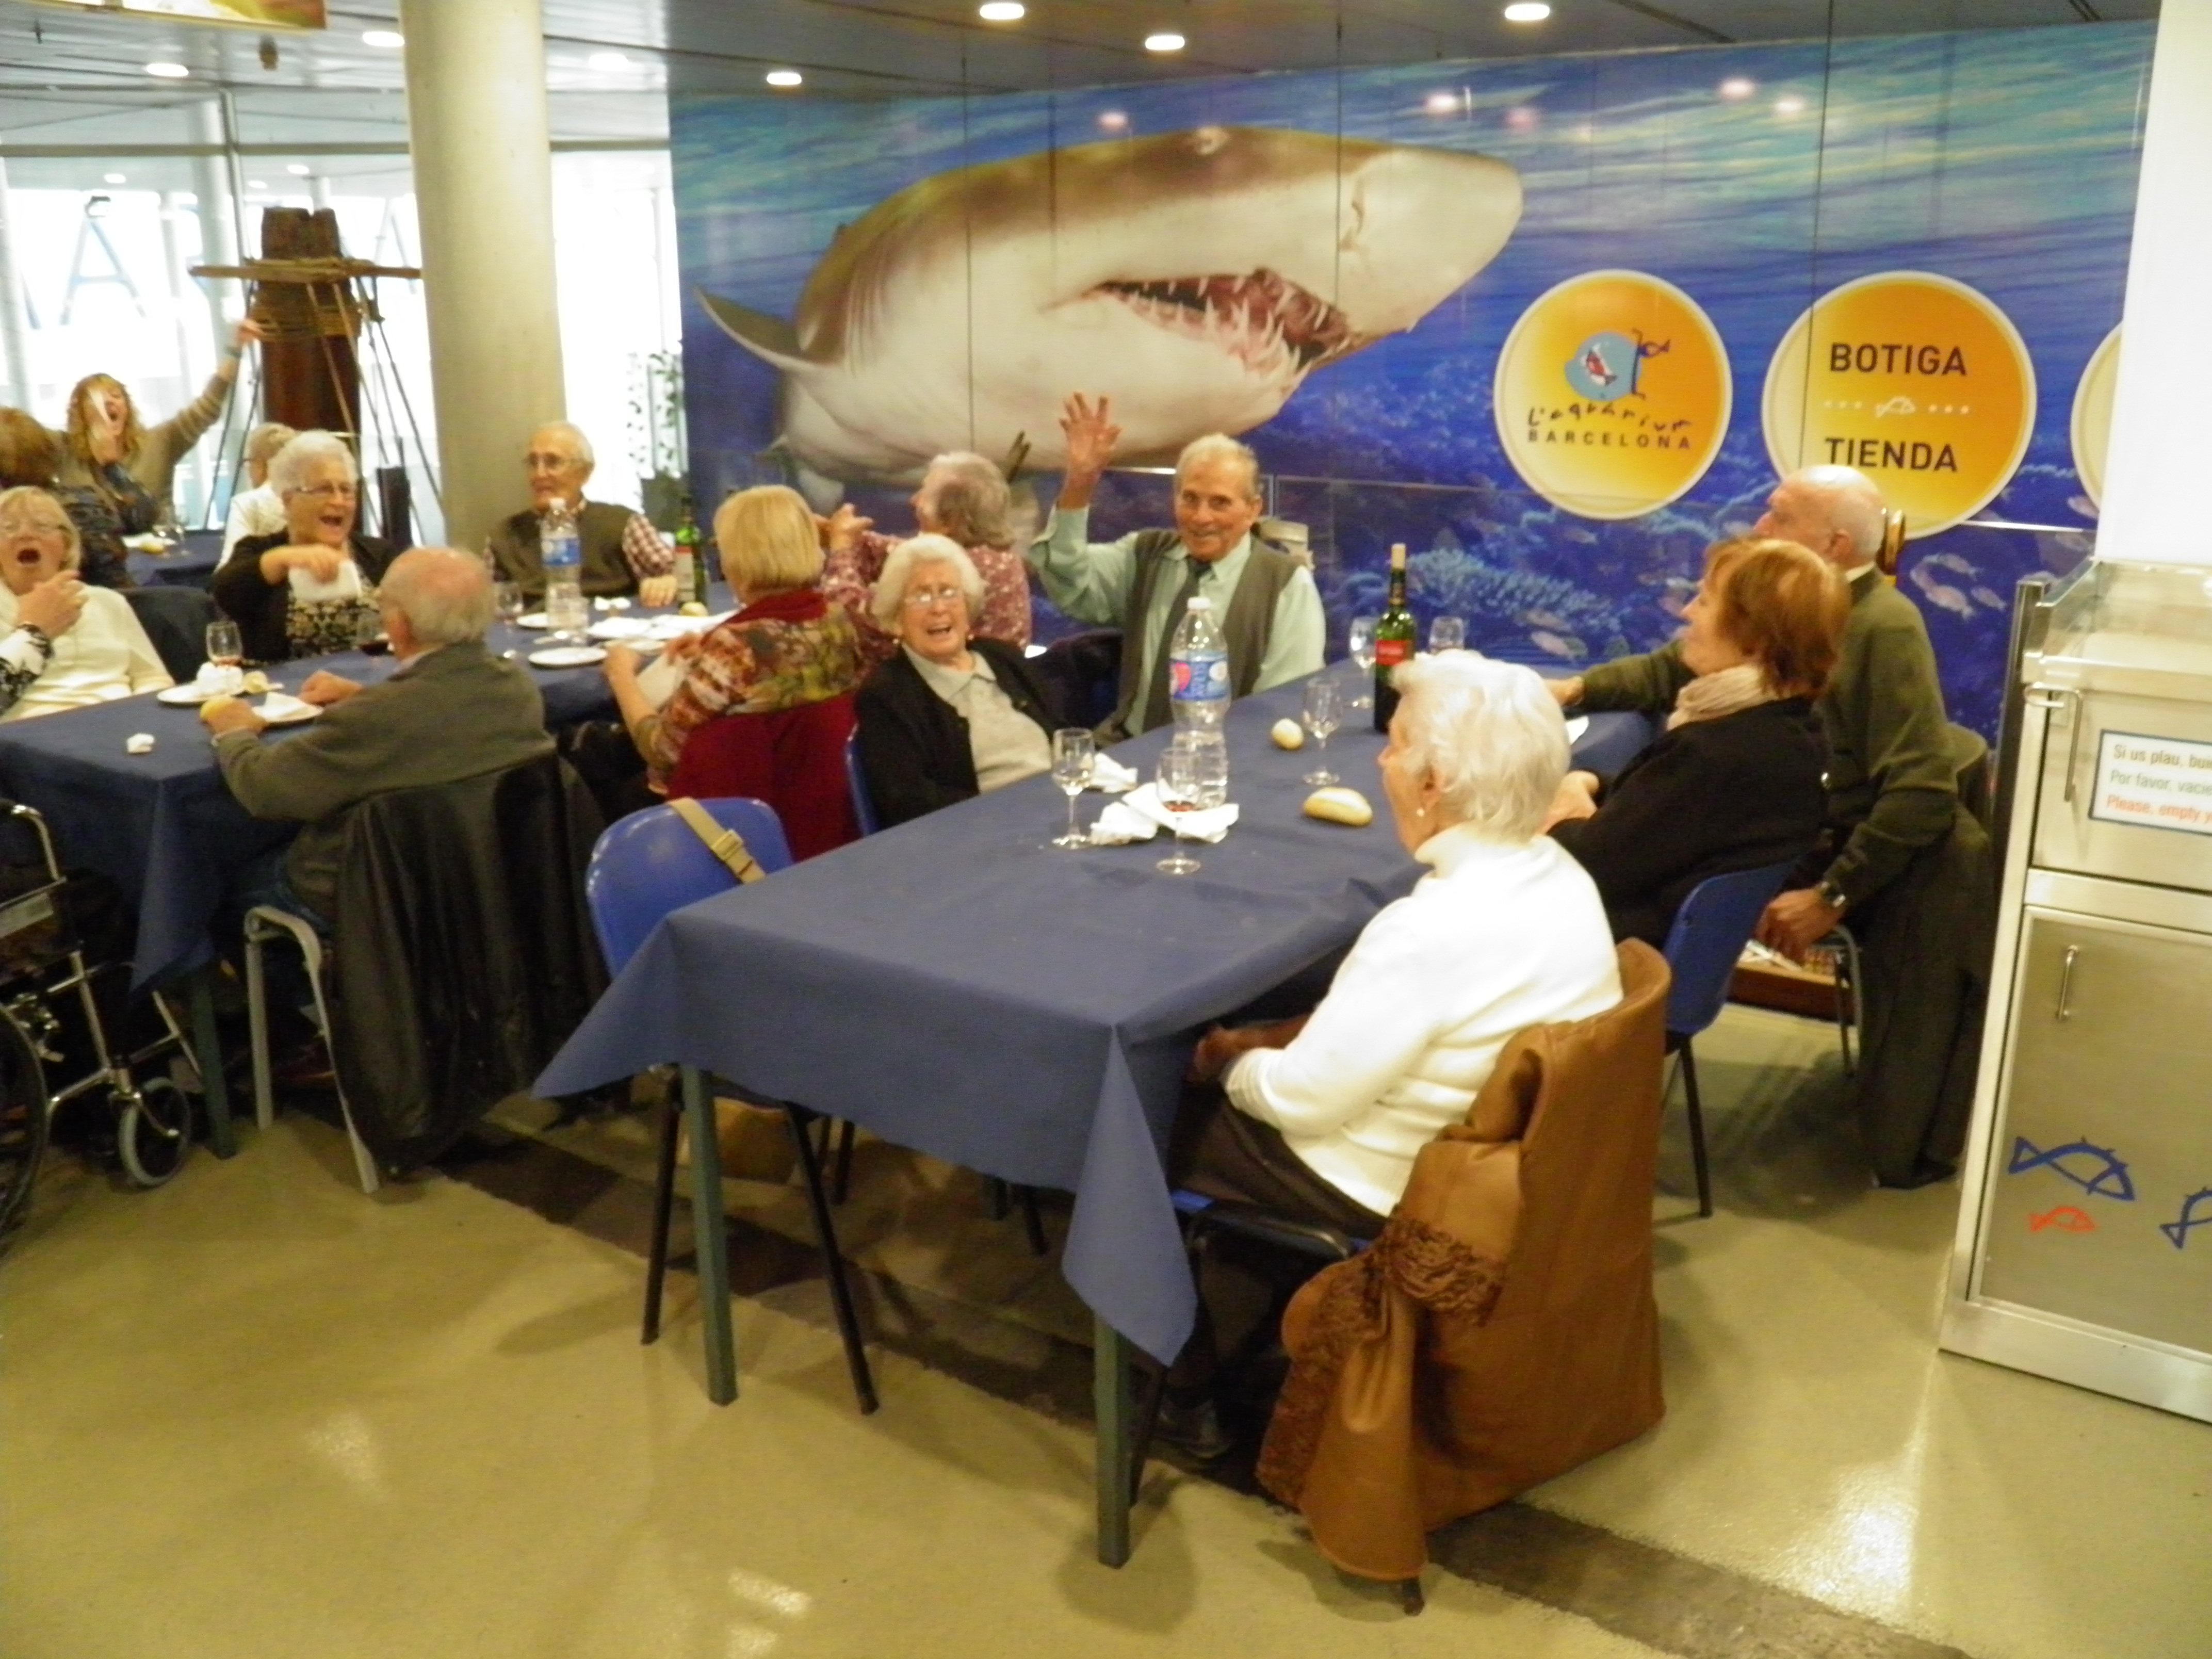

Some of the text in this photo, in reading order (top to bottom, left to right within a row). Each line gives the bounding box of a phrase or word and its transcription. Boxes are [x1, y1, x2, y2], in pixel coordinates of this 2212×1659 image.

[1830, 343, 1967, 377] BOTIGA
[1528, 429, 1690, 449] BARCELONA
[1825, 437, 1957, 472] TIENDA
[2114, 744, 2126, 759] Si
[2130, 750, 2146, 762] us
[2150, 750, 2184, 767] plau,
[2110, 769, 2132, 785] Por
[2136, 773, 2172, 792] favor,
[2158, 805, 2200, 824] empty
